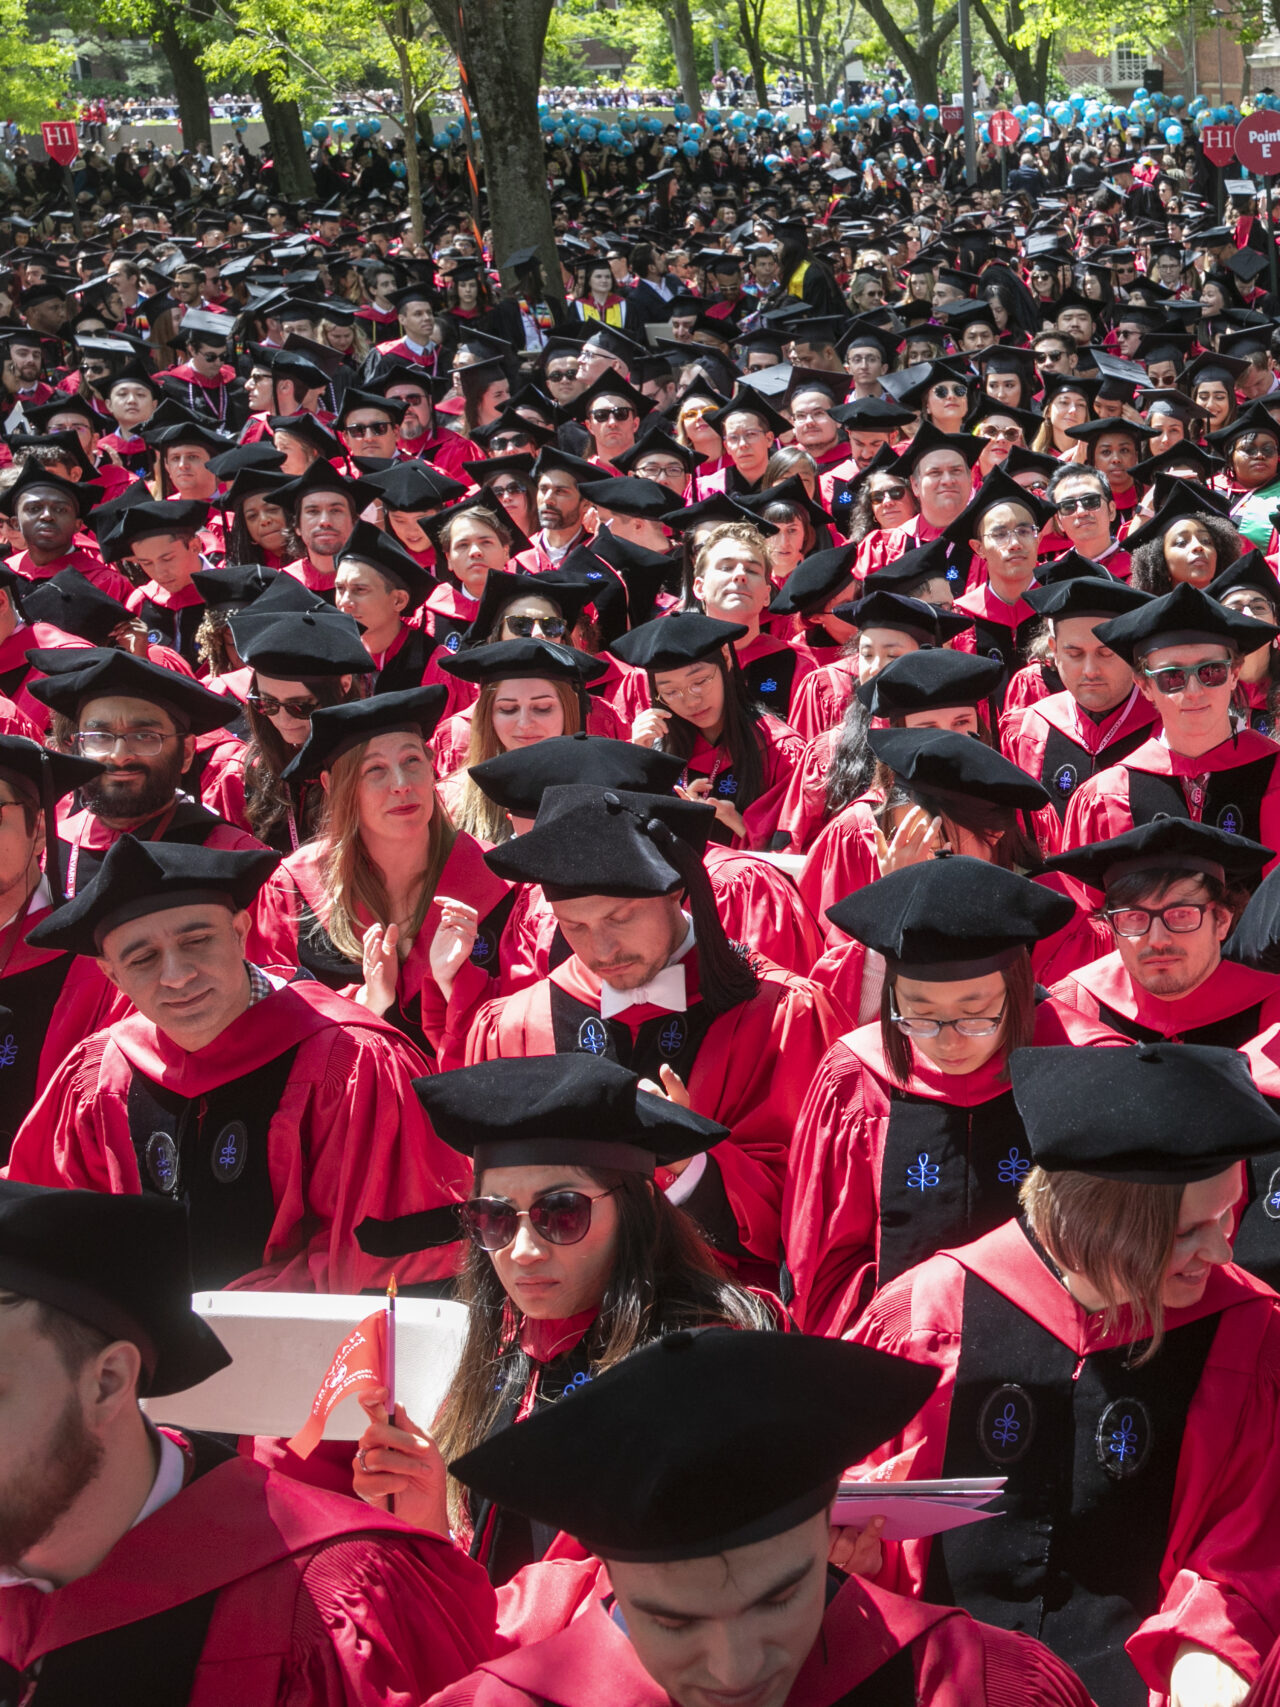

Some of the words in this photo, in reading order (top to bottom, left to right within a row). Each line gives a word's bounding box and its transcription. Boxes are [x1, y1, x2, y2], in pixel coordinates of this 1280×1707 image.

[943, 110, 961, 119] GSE
[44, 127, 71, 146] H1
[997, 126, 1012, 143] K
[1206, 130, 1232, 148] H1
[1261, 143, 1272, 158] E
